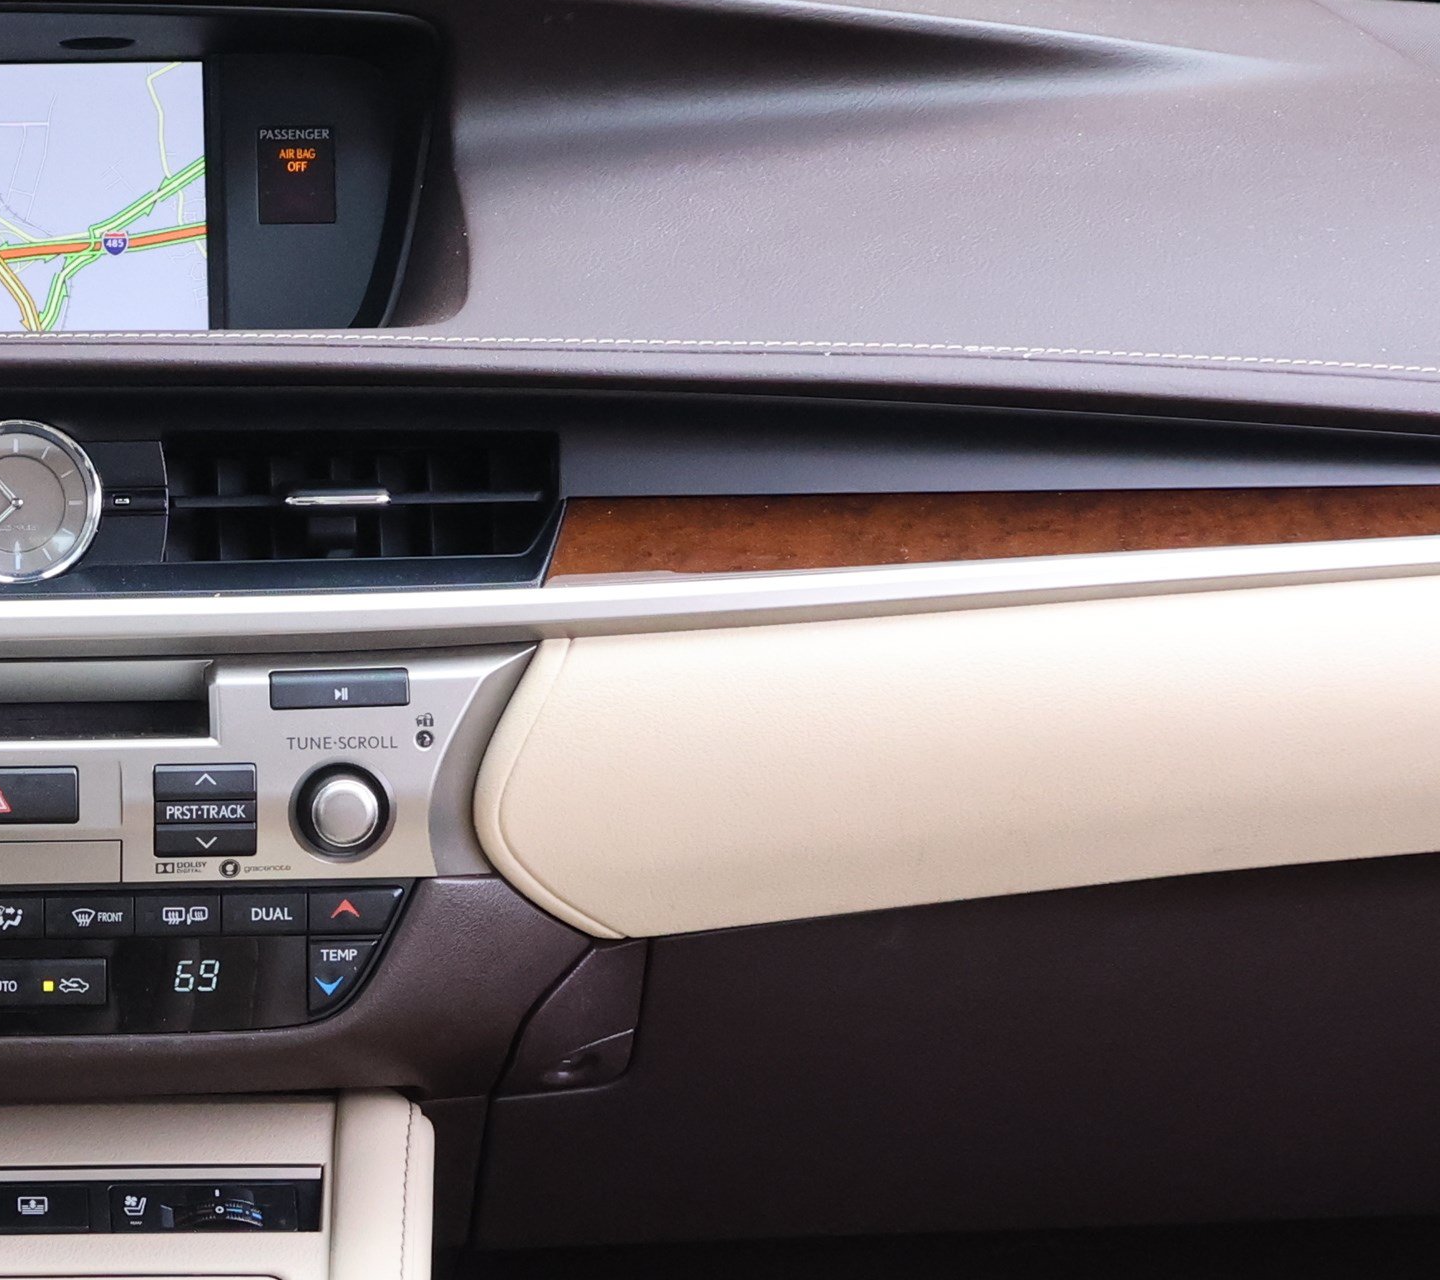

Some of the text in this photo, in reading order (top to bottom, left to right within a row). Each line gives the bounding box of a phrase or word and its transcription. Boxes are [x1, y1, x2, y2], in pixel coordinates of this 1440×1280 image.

[259, 128, 330, 140] PASSENGER
[279, 148, 317, 160] AIR BAG
[287, 161, 308, 173] OFF
[105, 238, 125, 249] 485
[98, 911, 124, 923] FRONT
[251, 907, 293, 921] DUAL
[320, 949, 358, 962] TEMP
[173, 960, 220, 992] 69
